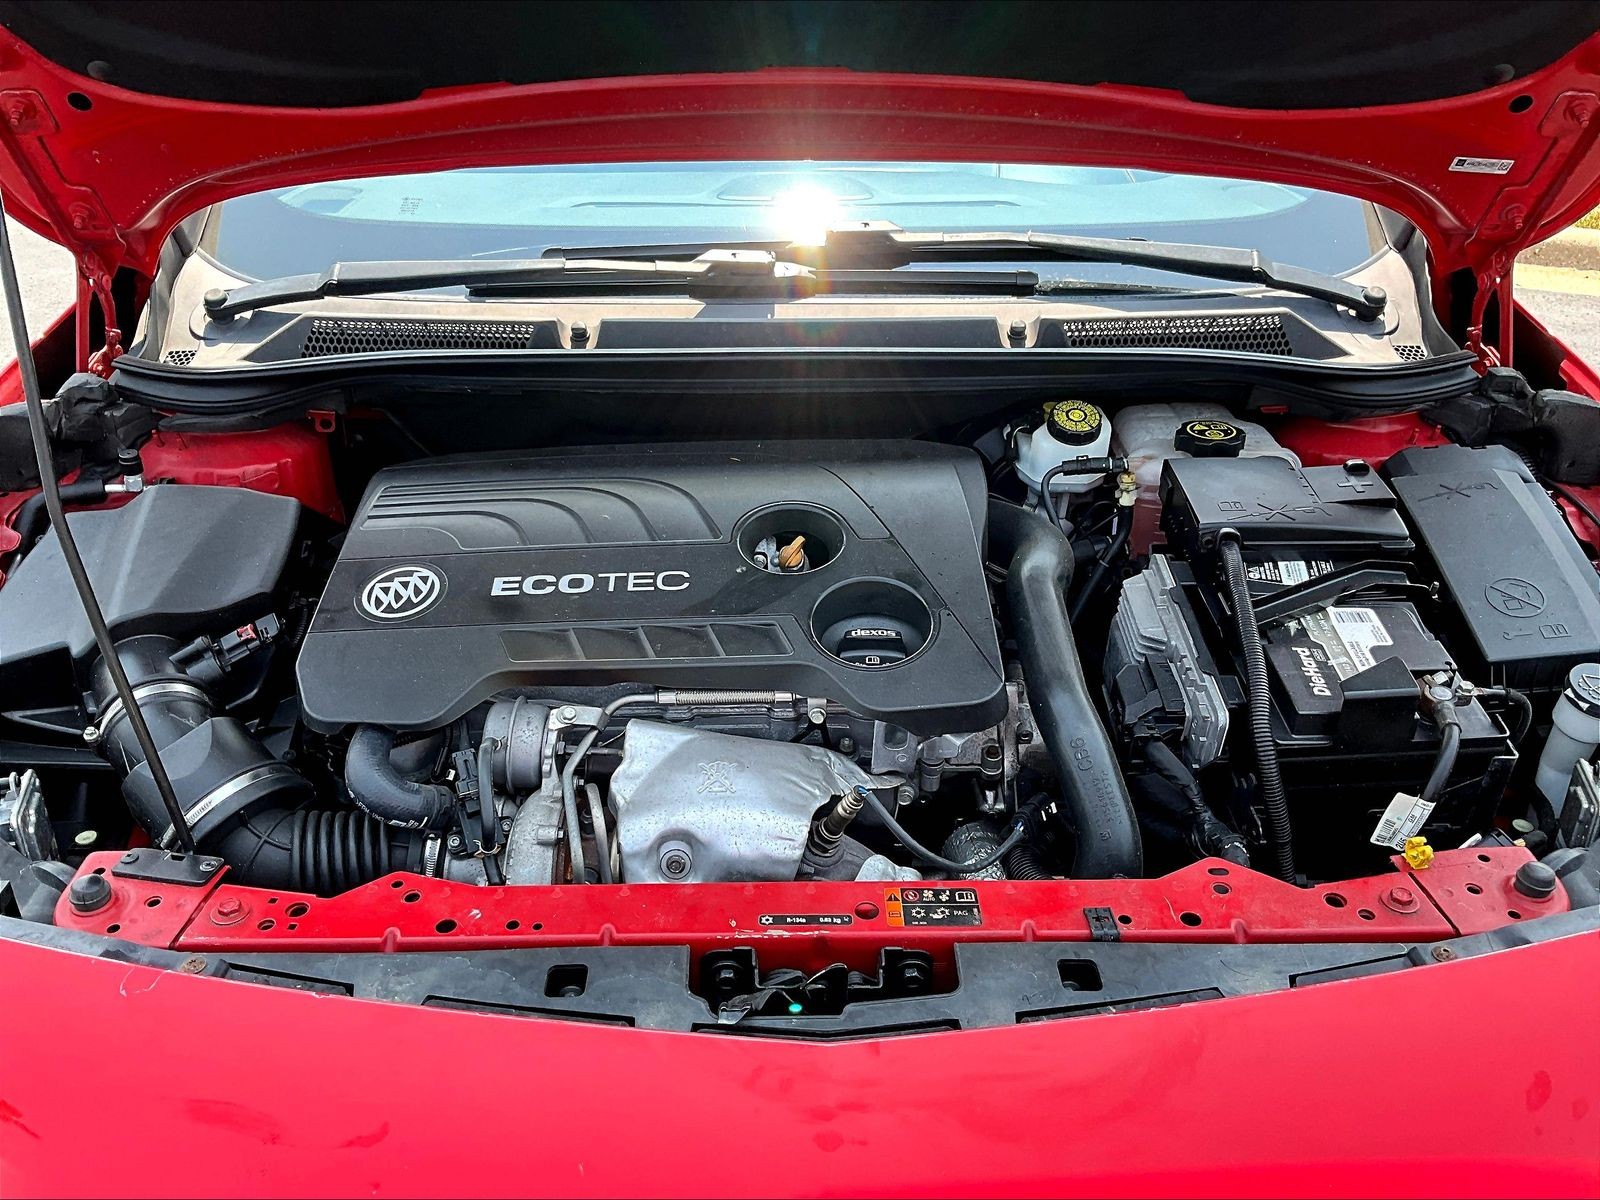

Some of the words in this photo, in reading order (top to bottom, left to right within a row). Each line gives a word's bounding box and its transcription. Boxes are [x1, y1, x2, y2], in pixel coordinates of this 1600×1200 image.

[490, 570, 691, 597] ECOTEC
[851, 628, 897, 637] dexos
[1291, 646, 1332, 696] DieHard
